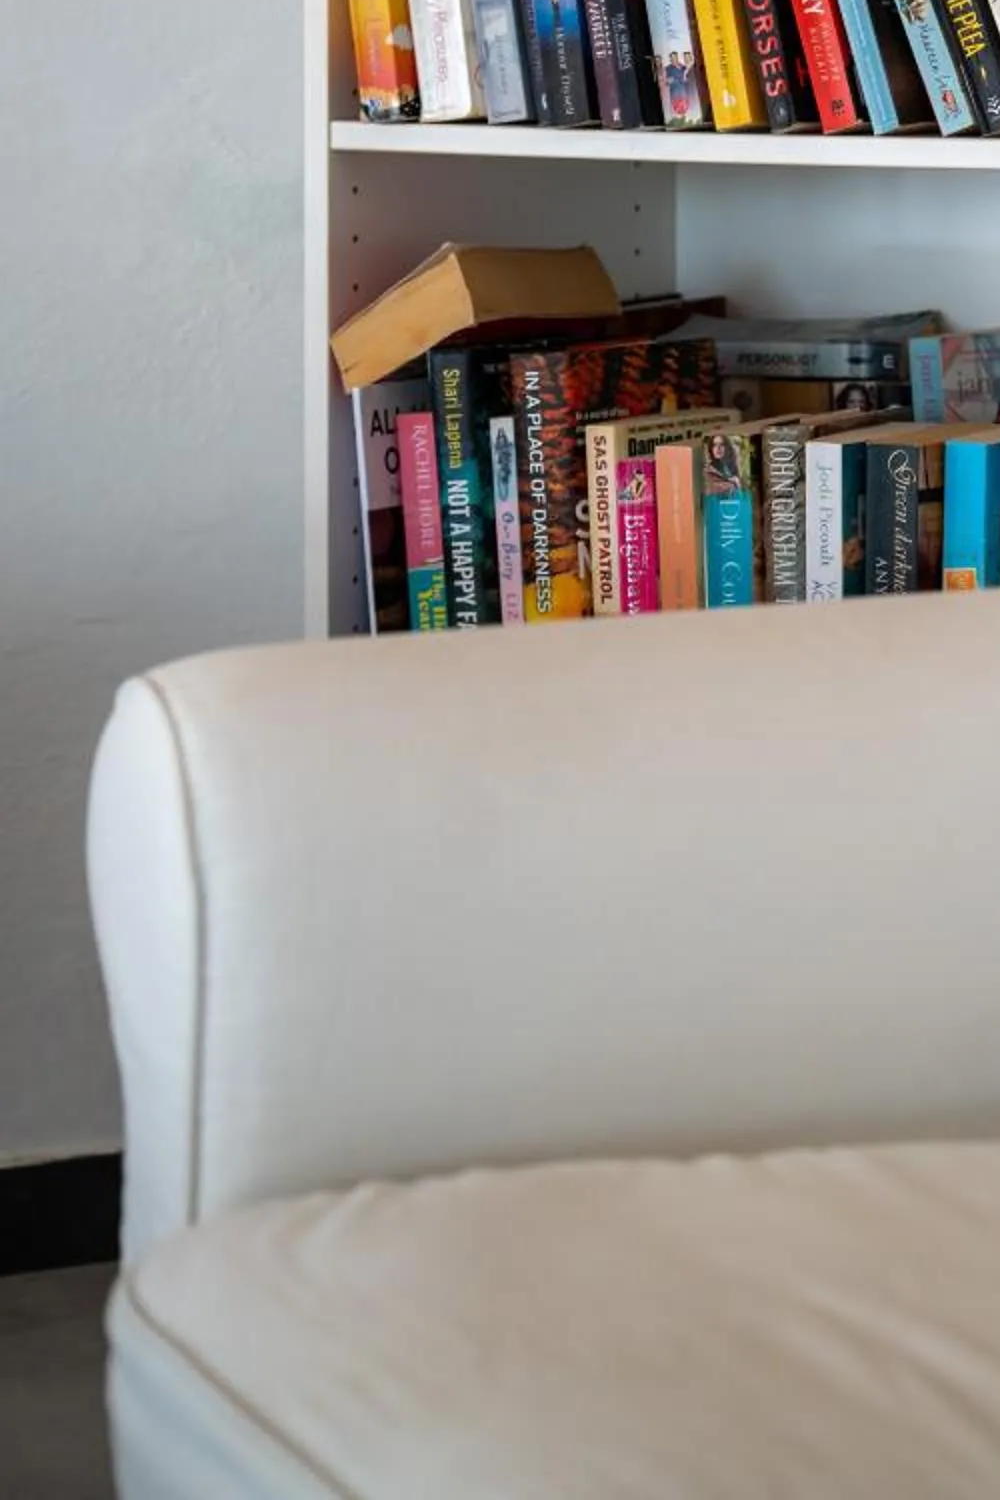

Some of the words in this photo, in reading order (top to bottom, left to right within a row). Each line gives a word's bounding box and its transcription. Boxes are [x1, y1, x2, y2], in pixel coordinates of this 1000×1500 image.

[949, 12, 987, 59] PLEA
[442, 368, 462, 409] Shari
[524, 371, 541, 392] IN
[526, 395, 542, 409] A
[411, 424, 431, 491] RACHEL
[444, 414, 465, 469] Lapena
[527, 413, 545, 474] PLACE
[593, 435, 608, 472] SAS
[769, 441, 797, 492] JOHN
[447, 479, 470, 517] NOT
[531, 479, 547, 506] OF
[595, 475, 611, 534] GHOST
[816, 463, 834, 501] Jodi
[887, 449, 917, 523] Green
[418, 499, 435, 550] HORE
[449, 523, 471, 537] A
[719, 499, 744, 549] Dilly
[771, 498, 798, 586] GRISHAM
[820, 506, 835, 567] Picoult
[451, 540, 476, 606] HAPPY
[532, 508, 553, 613] DARKNESS
[598, 537, 614, 605] PATROL
[720, 560, 742, 605] Cou
[892, 526, 912, 595] darkne
[456, 611, 478, 630] FA
